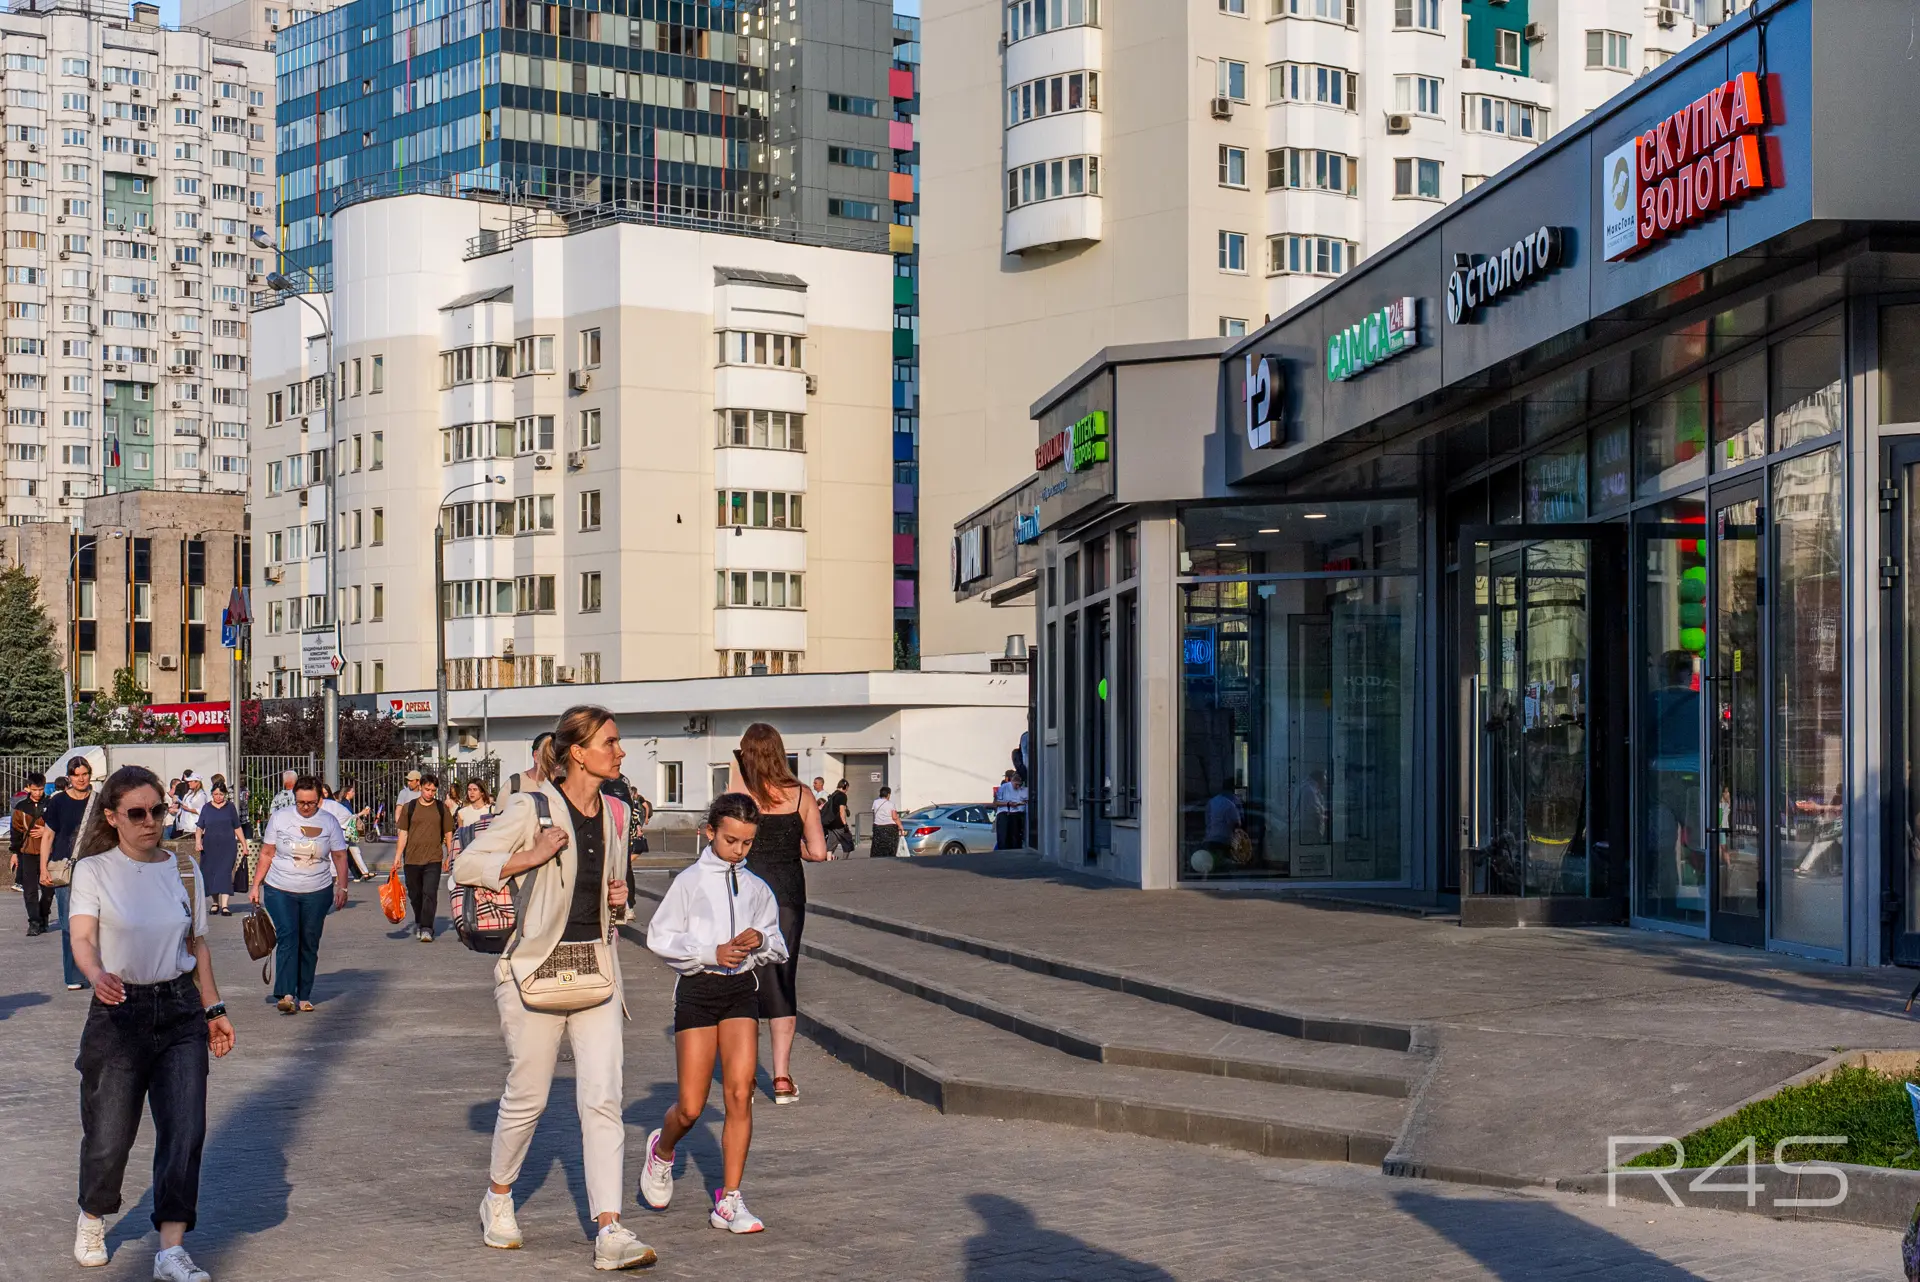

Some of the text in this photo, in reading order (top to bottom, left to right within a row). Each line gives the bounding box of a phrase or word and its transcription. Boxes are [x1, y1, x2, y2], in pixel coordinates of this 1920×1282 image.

[1640, 72, 1749, 182] СКУПКА
[1640, 136, 1750, 239] ЗОЛОТА
[1466, 226, 1549, 308] СТОЛОТО
[1327, 307, 1390, 382] САМСА
[1390, 302, 1401, 331] 24
[1073, 412, 1096, 448] АПТЕКА
[405, 701, 431, 712] ОРТЕКА
